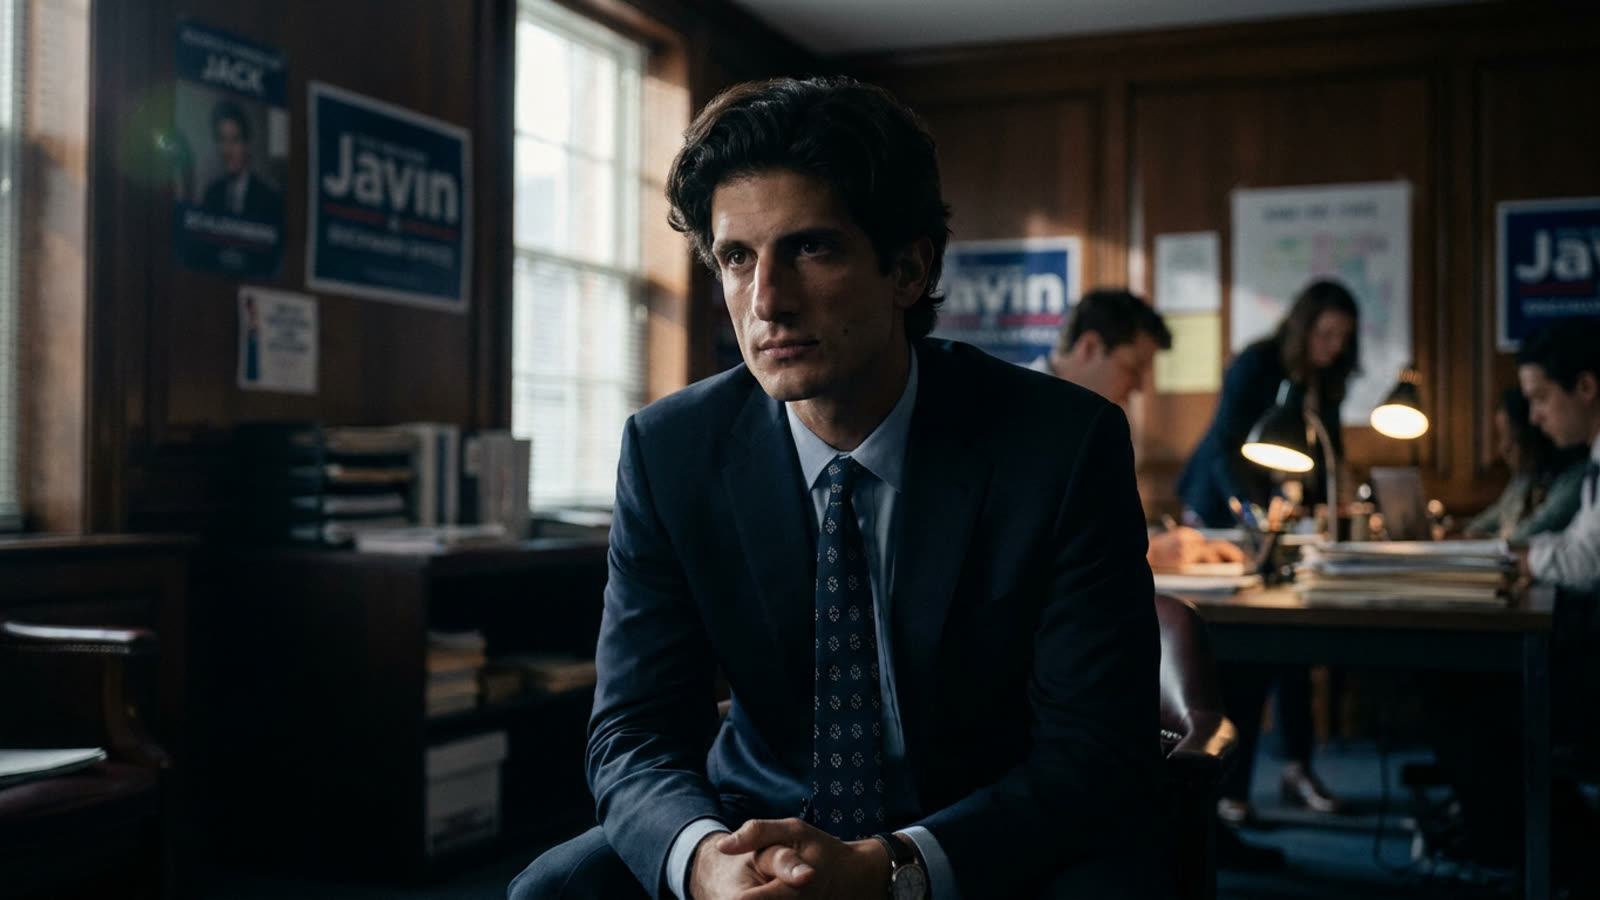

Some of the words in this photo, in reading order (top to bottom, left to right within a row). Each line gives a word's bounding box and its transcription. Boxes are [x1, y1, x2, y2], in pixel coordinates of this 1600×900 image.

[203, 53, 264, 92] JACK
[322, 132, 459, 225] Javin
[1513, 228, 1600, 284] Ja
